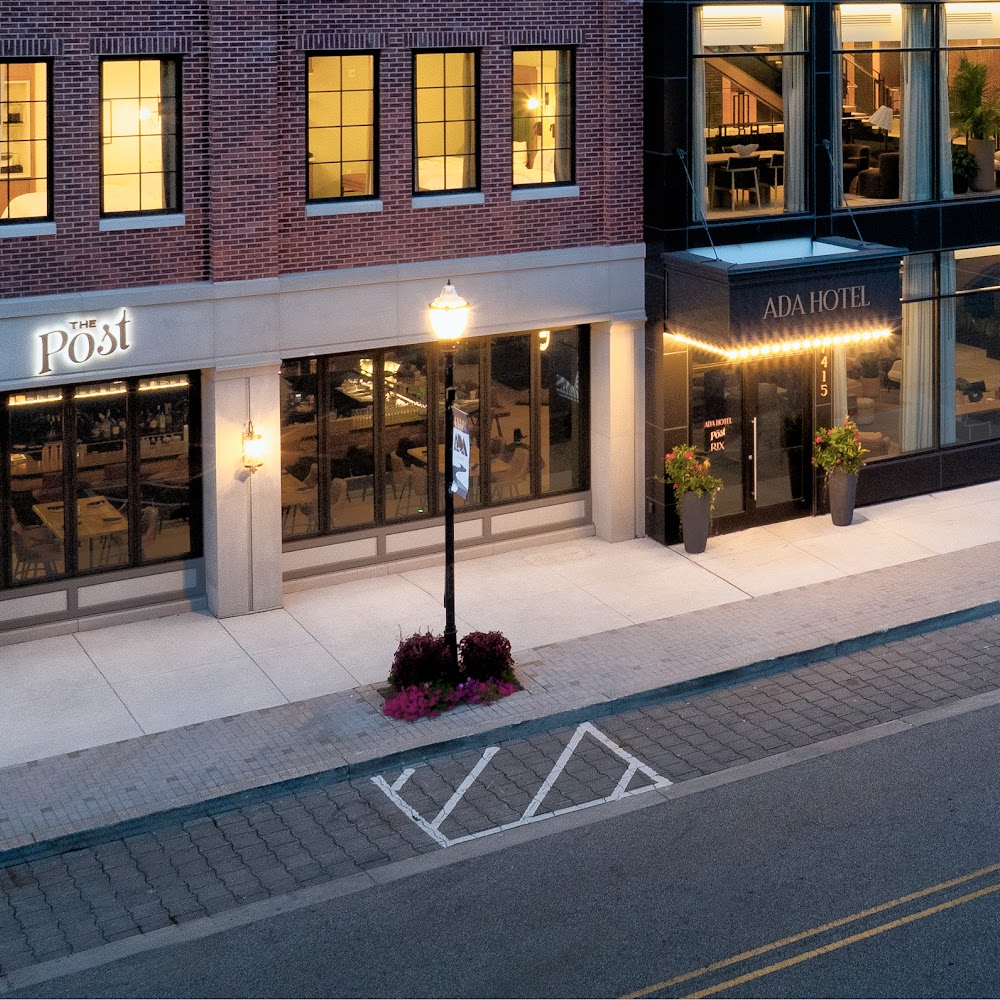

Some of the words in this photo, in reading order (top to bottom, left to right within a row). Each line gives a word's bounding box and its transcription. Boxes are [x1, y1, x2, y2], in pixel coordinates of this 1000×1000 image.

[763, 293, 806, 319] ADA
[810, 285, 871, 313] HOTEL
[69, 319, 97, 330] THE
[38, 309, 131, 375] Post
[704, 419, 716, 428] ADA
[715, 416, 733, 426] HOTEL
[710, 441, 725, 452] RIX
